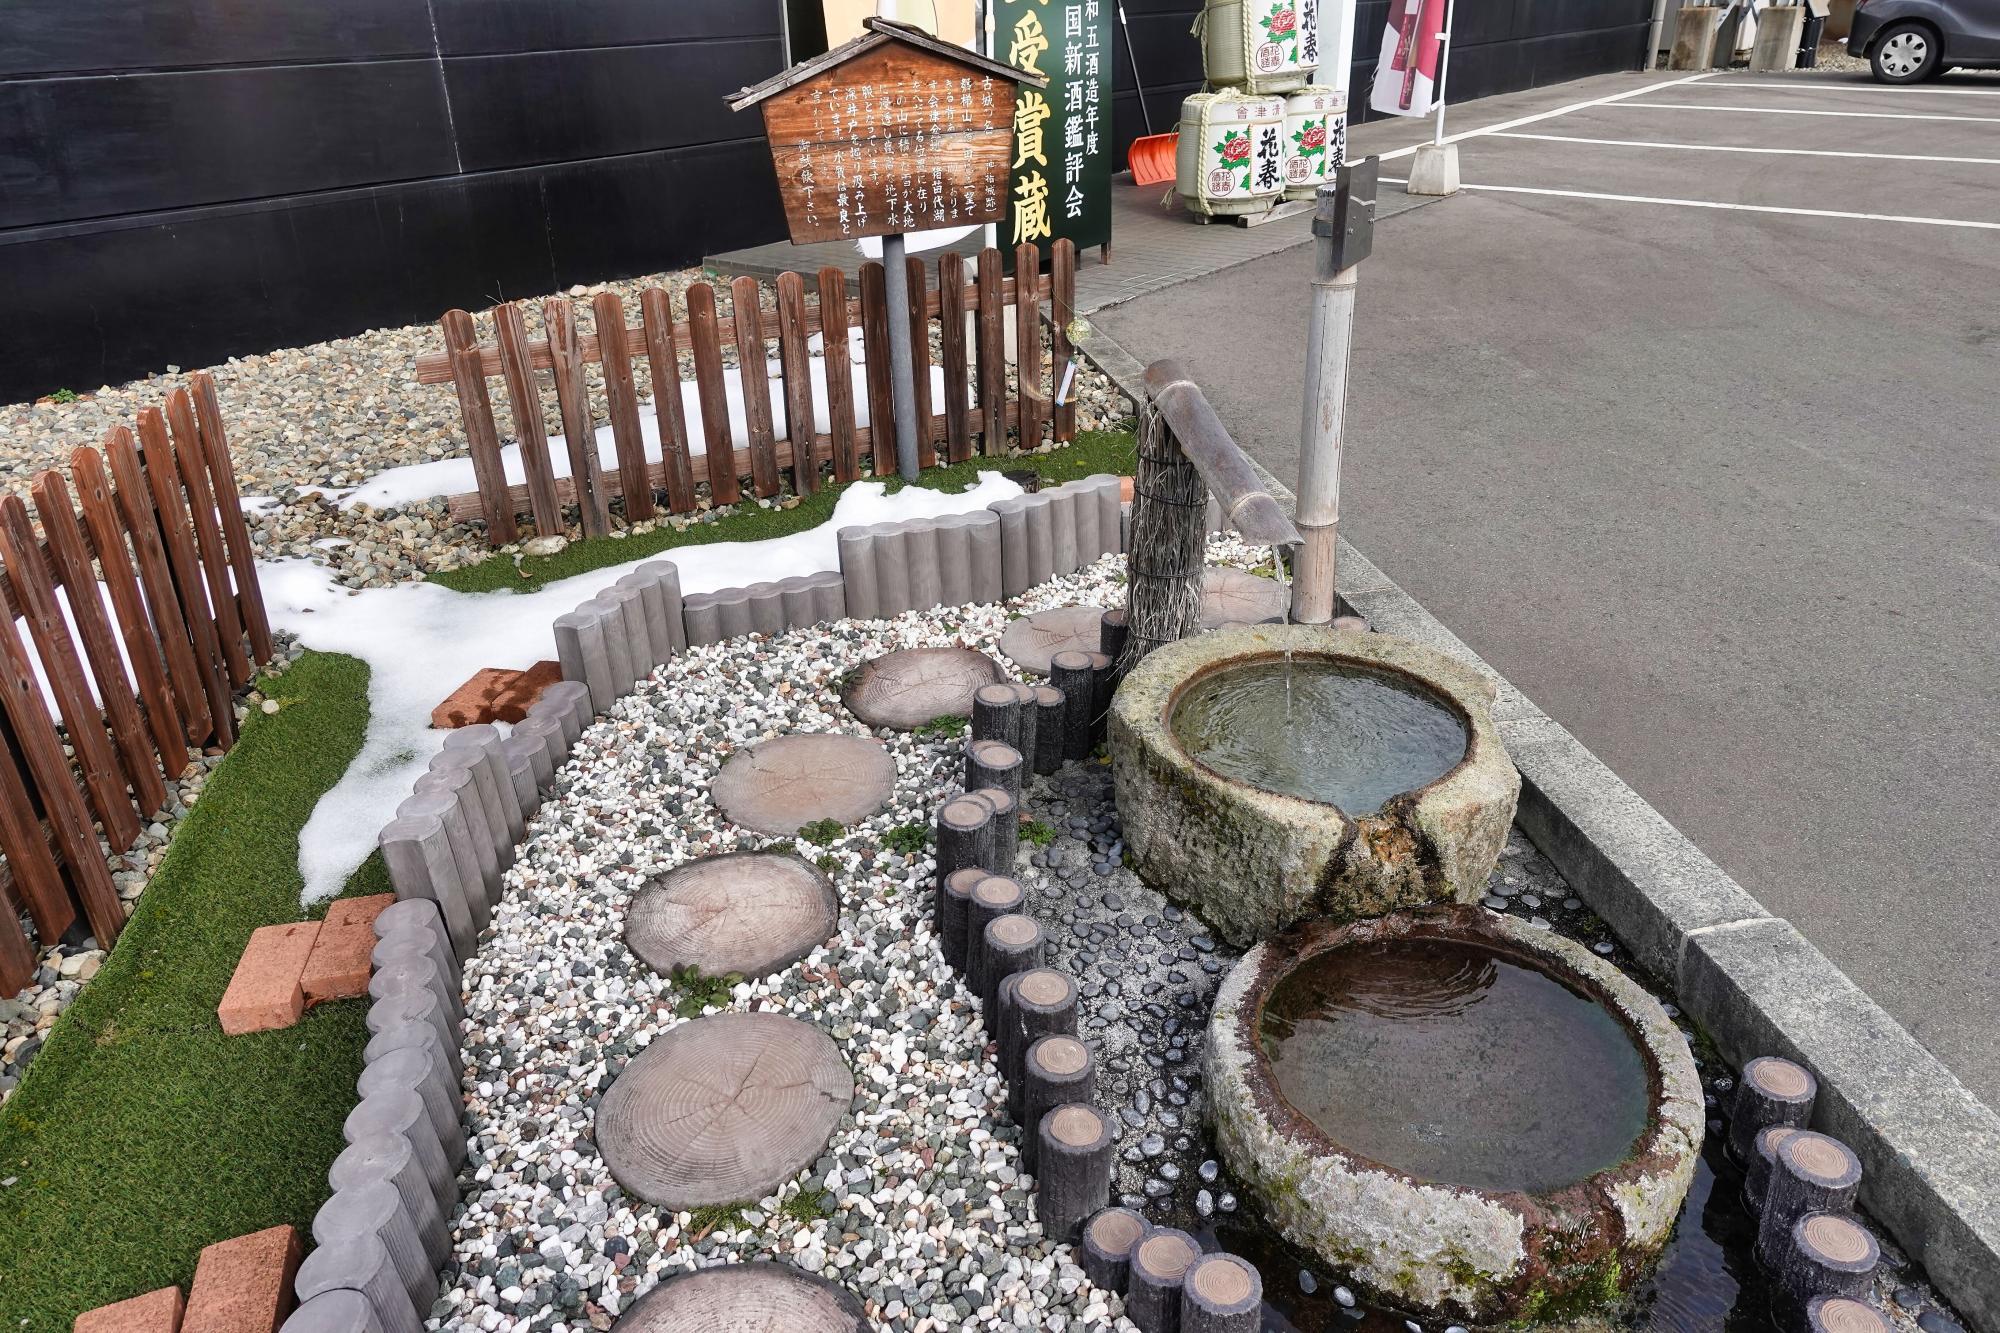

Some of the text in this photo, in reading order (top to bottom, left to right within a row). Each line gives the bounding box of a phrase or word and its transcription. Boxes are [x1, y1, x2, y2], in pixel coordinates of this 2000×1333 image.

[1302, 0, 1318, 63] 花春
[1005, 0, 1051, 244] 受賞蔵
[1065, 5, 1084, 218] 国新酒鑑評会
[1256, 127, 1279, 189] 花春
[1328, 117, 1344, 173] 花春
